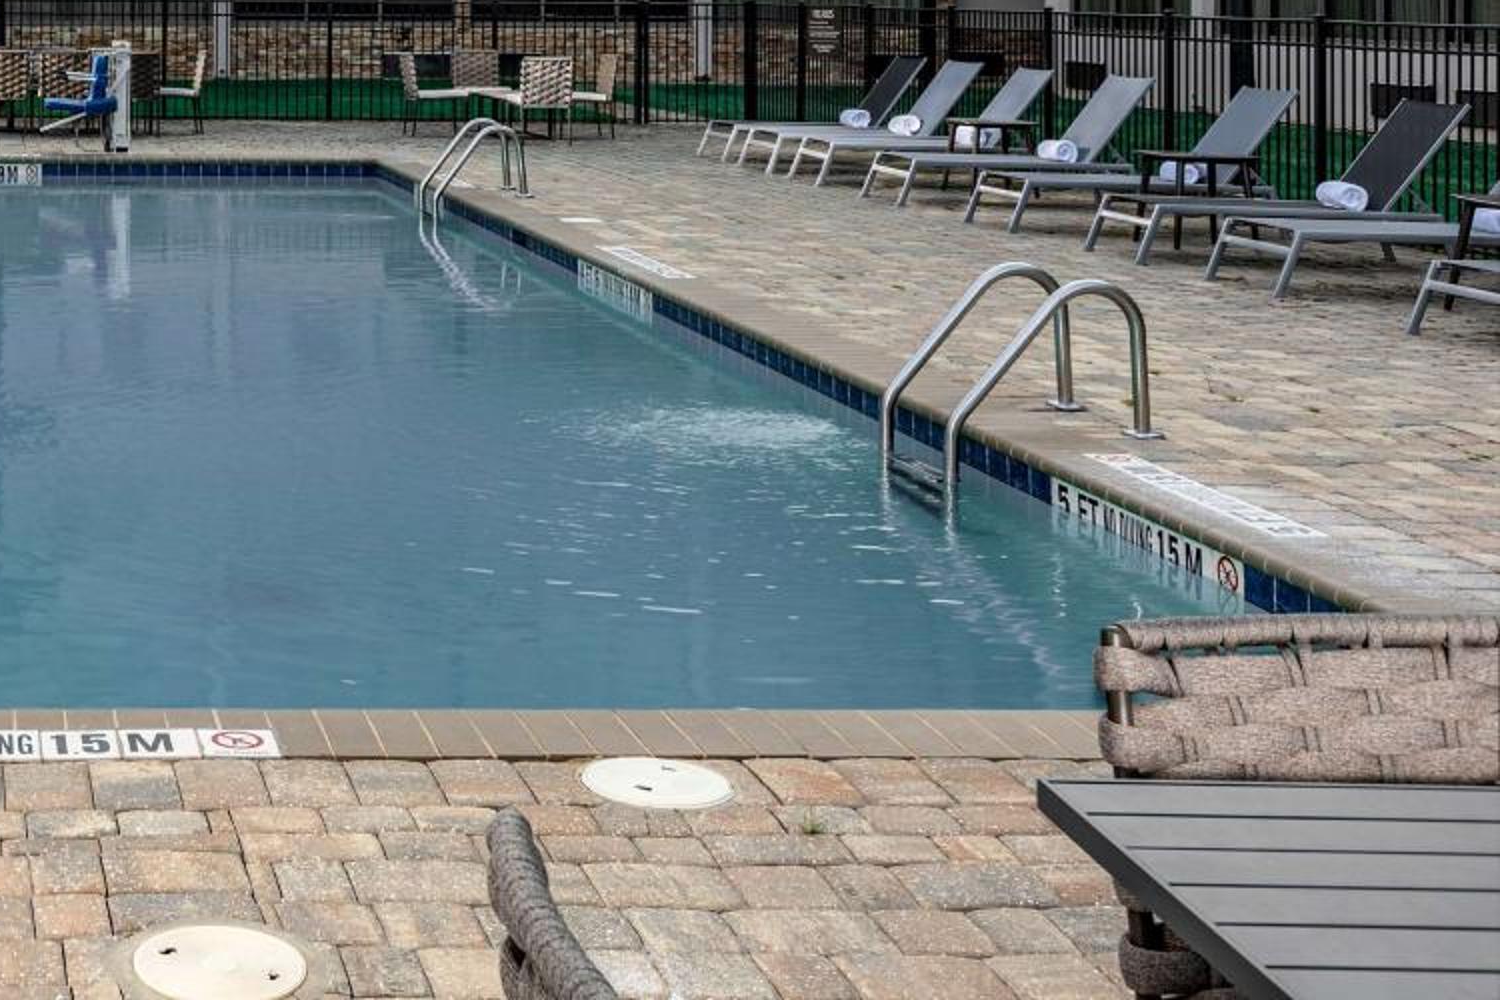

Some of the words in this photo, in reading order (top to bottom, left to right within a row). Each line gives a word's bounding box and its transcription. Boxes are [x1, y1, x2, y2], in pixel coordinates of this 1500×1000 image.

[1058, 482, 1071, 513] 5
[1077, 493, 1098, 527] FT
[1185, 541, 1203, 578] M
[127, 732, 174, 753] M
